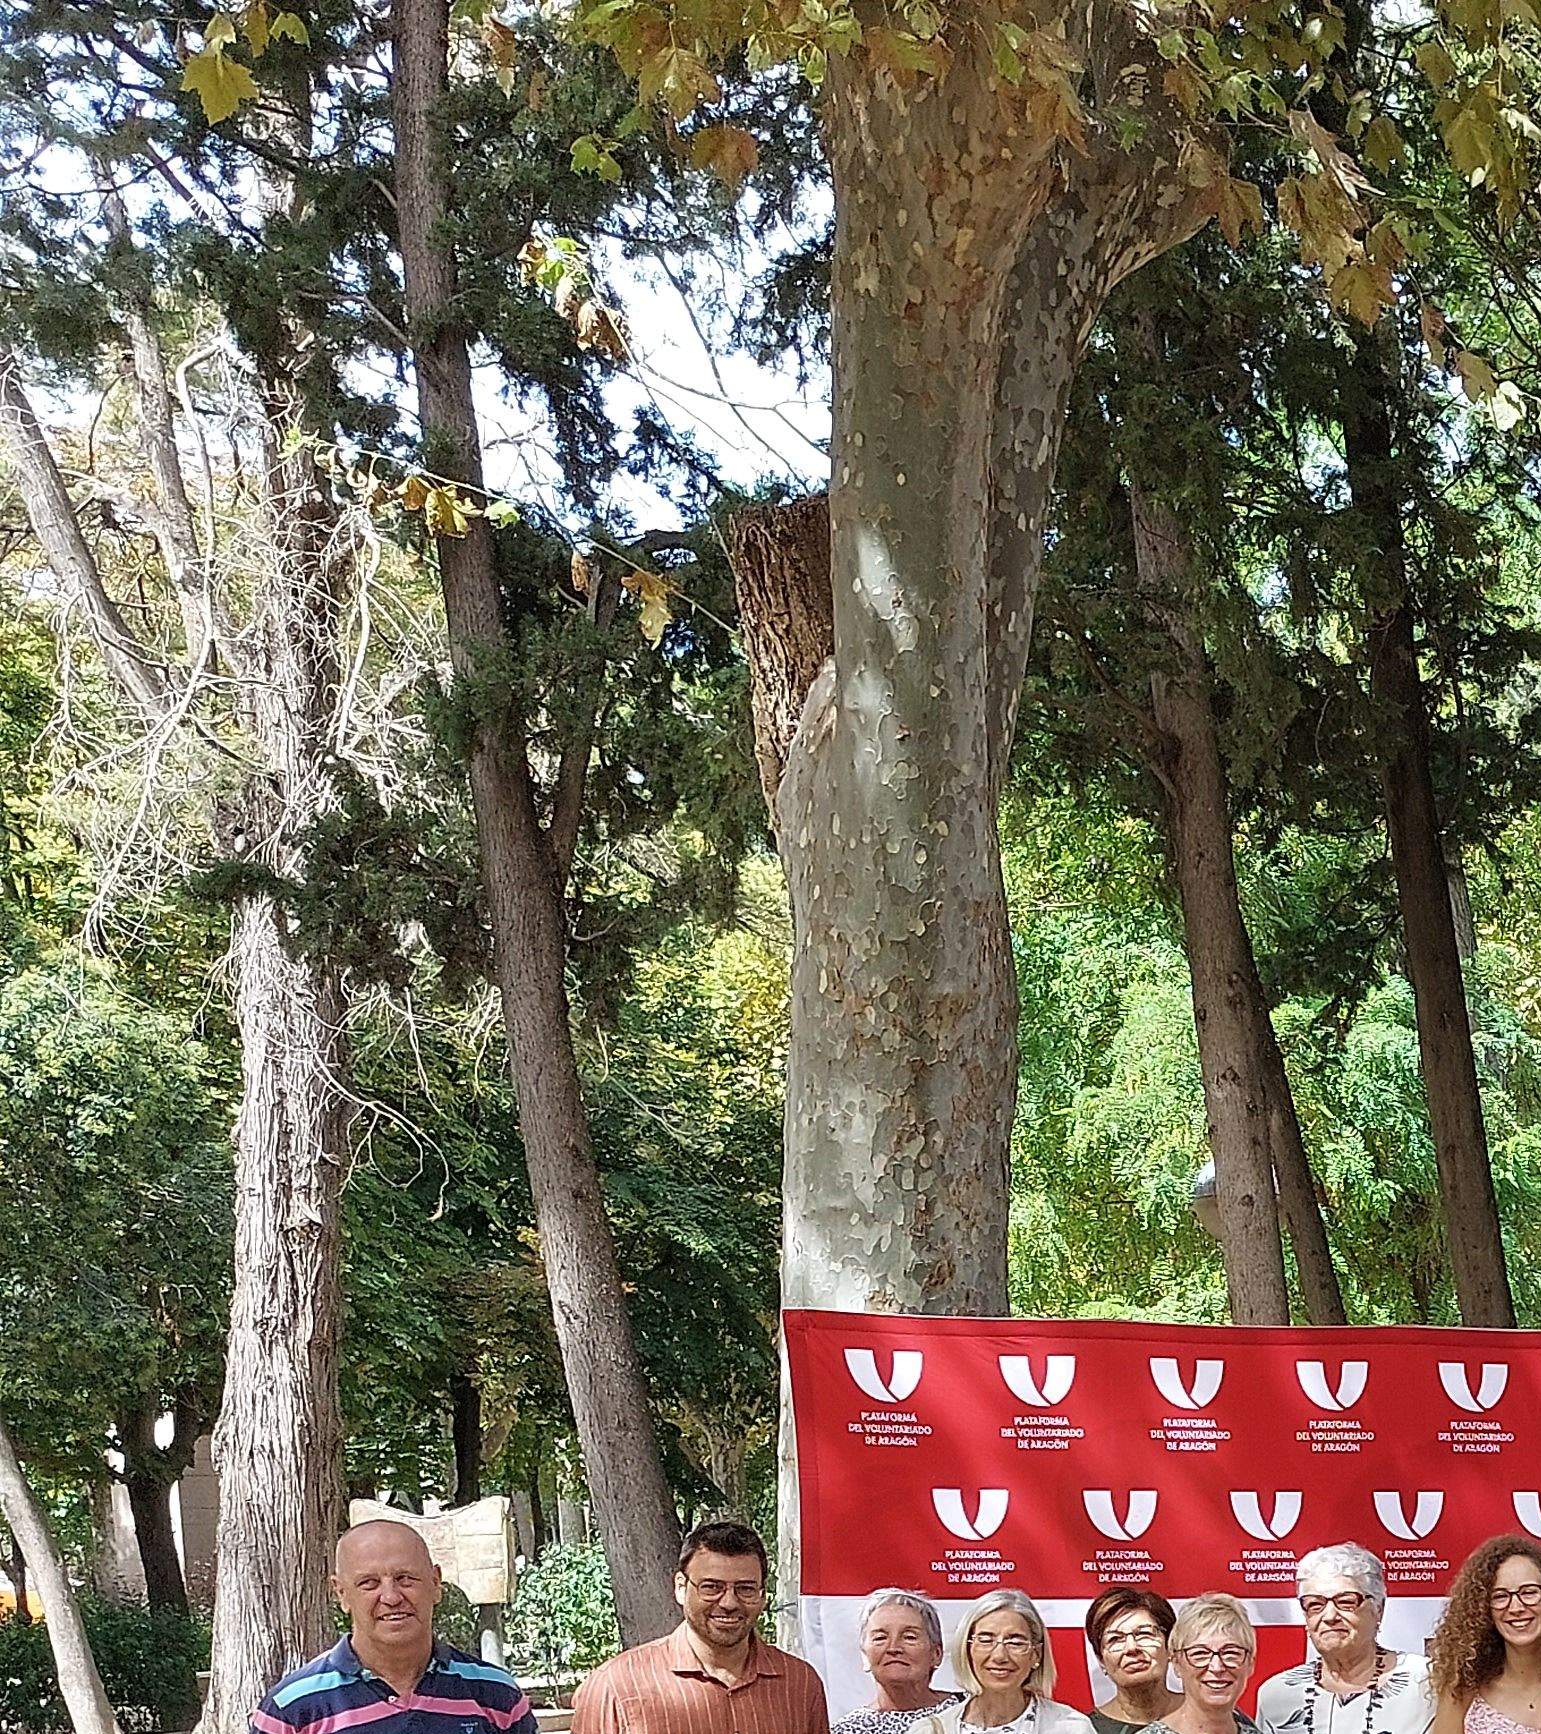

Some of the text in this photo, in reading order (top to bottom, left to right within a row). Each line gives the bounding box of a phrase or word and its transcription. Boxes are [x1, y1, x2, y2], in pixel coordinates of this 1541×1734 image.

[861, 1412, 917, 1422] PLATAFORMA
[1014, 1417, 1069, 1425] PLATAFORMA
[1163, 1419, 1217, 1428] PLATAFORMA
[1310, 1421, 1361, 1429] PLATAFORMA
[1451, 1422, 1501, 1430] PLATAFORMA
[849, 1424, 863, 1432] DEL
[1001, 1429, 1016, 1437] DEL
[1150, 1430, 1166, 1438] DEL
[1297, 1432, 1310, 1440] DEL
[946, 1551, 1001, 1559] PLATAFORMA
[1096, 1551, 1151, 1559] PLATAFORMA
[1243, 1551, 1296, 1559] PLATAFORMA
[1385, 1550, 1436, 1558] PLATAFORMA
[932, 1562, 948, 1570] DEL
[1083, 1562, 1099, 1570] DEL
[1230, 1561, 1301, 1571] DEL VOLUNTARIA
